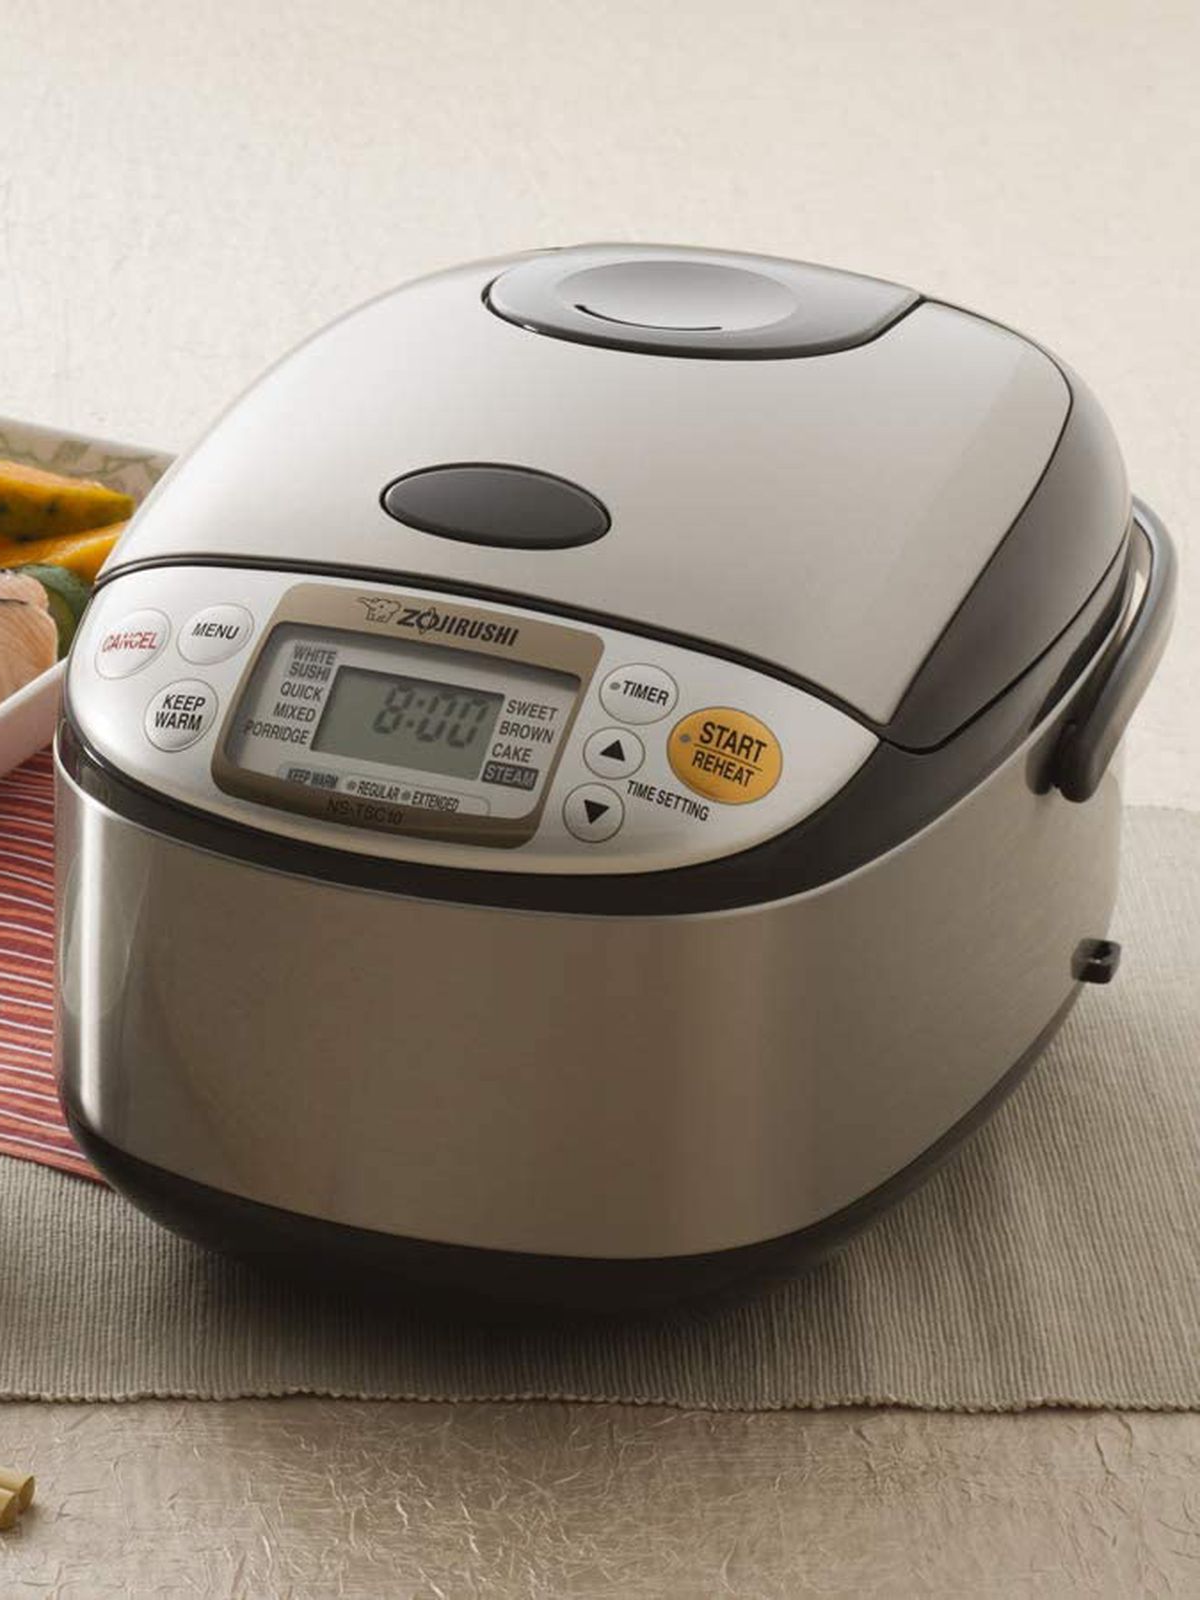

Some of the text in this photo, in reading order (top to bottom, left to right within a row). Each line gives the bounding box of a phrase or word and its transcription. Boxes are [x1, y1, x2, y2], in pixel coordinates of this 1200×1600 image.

[192, 622, 239, 640] MENU
[397, 607, 519, 646] ZOJIRUSHI
[102, 631, 158, 652] CANCEL
[293, 645, 336, 665] WHITE
[289, 662, 332, 681] SUSHI
[280, 681, 324, 701] QUICK
[622, 680, 669, 706] TIMER
[162, 694, 206, 711] KEEP
[273, 702, 316, 722] MIXED
[506, 699, 558, 721] SWEET
[154, 710, 202, 731] WARM
[373, 686, 489, 748] 8:00
[244, 720, 310, 745] PORRIDGE
[499, 720, 554, 744] BROWN
[699, 721, 767, 763] START
[491, 742, 533, 763] CAKE
[484, 764, 536, 786] STEAM
[691, 750, 755, 788] REHEAT
[356, 780, 399, 800] REGULAR
[626, 780, 710, 822] TIME SETTING
[410, 791, 460, 813] EXTENDED
